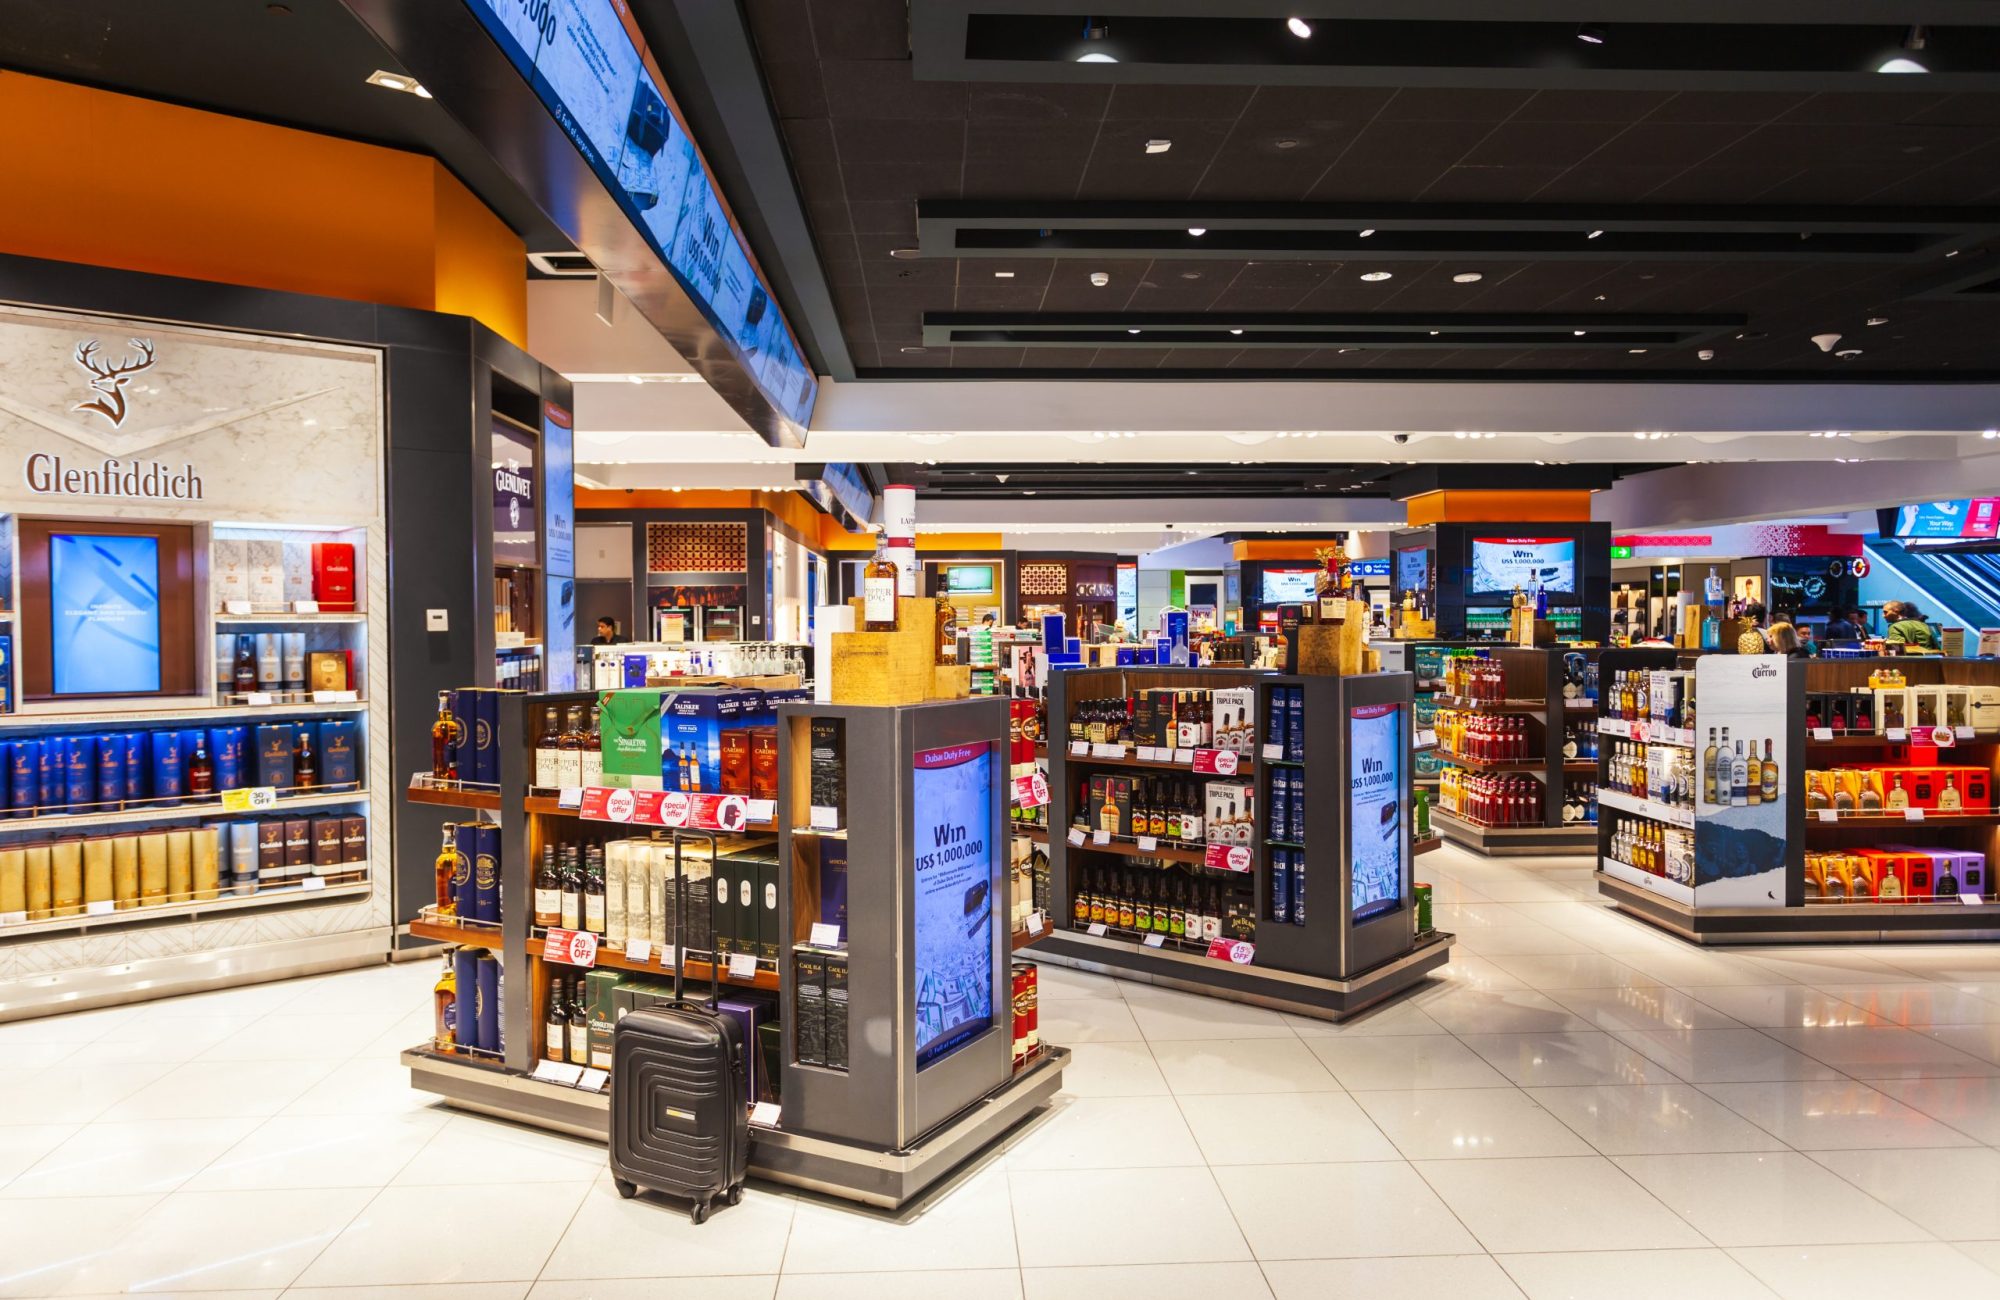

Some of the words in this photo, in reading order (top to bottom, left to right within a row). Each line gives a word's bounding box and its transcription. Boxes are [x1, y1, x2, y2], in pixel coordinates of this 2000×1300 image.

[702, 212, 721, 257] Win
[508, 458, 520, 475] THE
[26, 452, 204, 500] Glenfiddich
[495, 470, 532, 500] GLENLIVET
[1512, 550, 1534, 558] Win
[1075, 582, 1114, 597] CIGARS
[1752, 667, 1777, 679] Cuervo
[717, 701, 740, 710] TALISKER
[1216, 697, 1232, 705] TRIPLE
[1231, 698, 1244, 706] PACK
[618, 736, 647, 747] SINGLETON
[924, 753, 943, 764] Dubai
[943, 750, 958, 761] Duty
[958, 748, 972, 758] Free
[1361, 757, 1383, 774] Win
[1363, 772, 1394, 787] 1,000,000
[1036, 788, 1047, 799] OFF
[1208, 789, 1223, 798] TRIPLE
[1222, 791, 1235, 800] PACK
[610, 798, 632, 806] special
[664, 801, 687, 810] special
[612, 805, 628, 814] offer
[666, 809, 683, 818] offer
[343, 835, 366, 843] Glenfiddich
[933, 823, 967, 848] Win
[260, 841, 284, 849] Glenfiddich
[286, 838, 310, 846] Glenfiddich
[317, 838, 341, 846] Glenfiddich
[915, 853, 935, 872] US$
[936, 839, 983, 867] 1,000,000
[1229, 852, 1249, 861] special
[1230, 858, 1245, 866] offer
[574, 948, 592, 960] OFF
[1235, 945, 1251, 954] 15%
[1233, 951, 1249, 960] OFF
[799, 962, 813, 970] CAOL
[827, 965, 841, 974] CAOL
